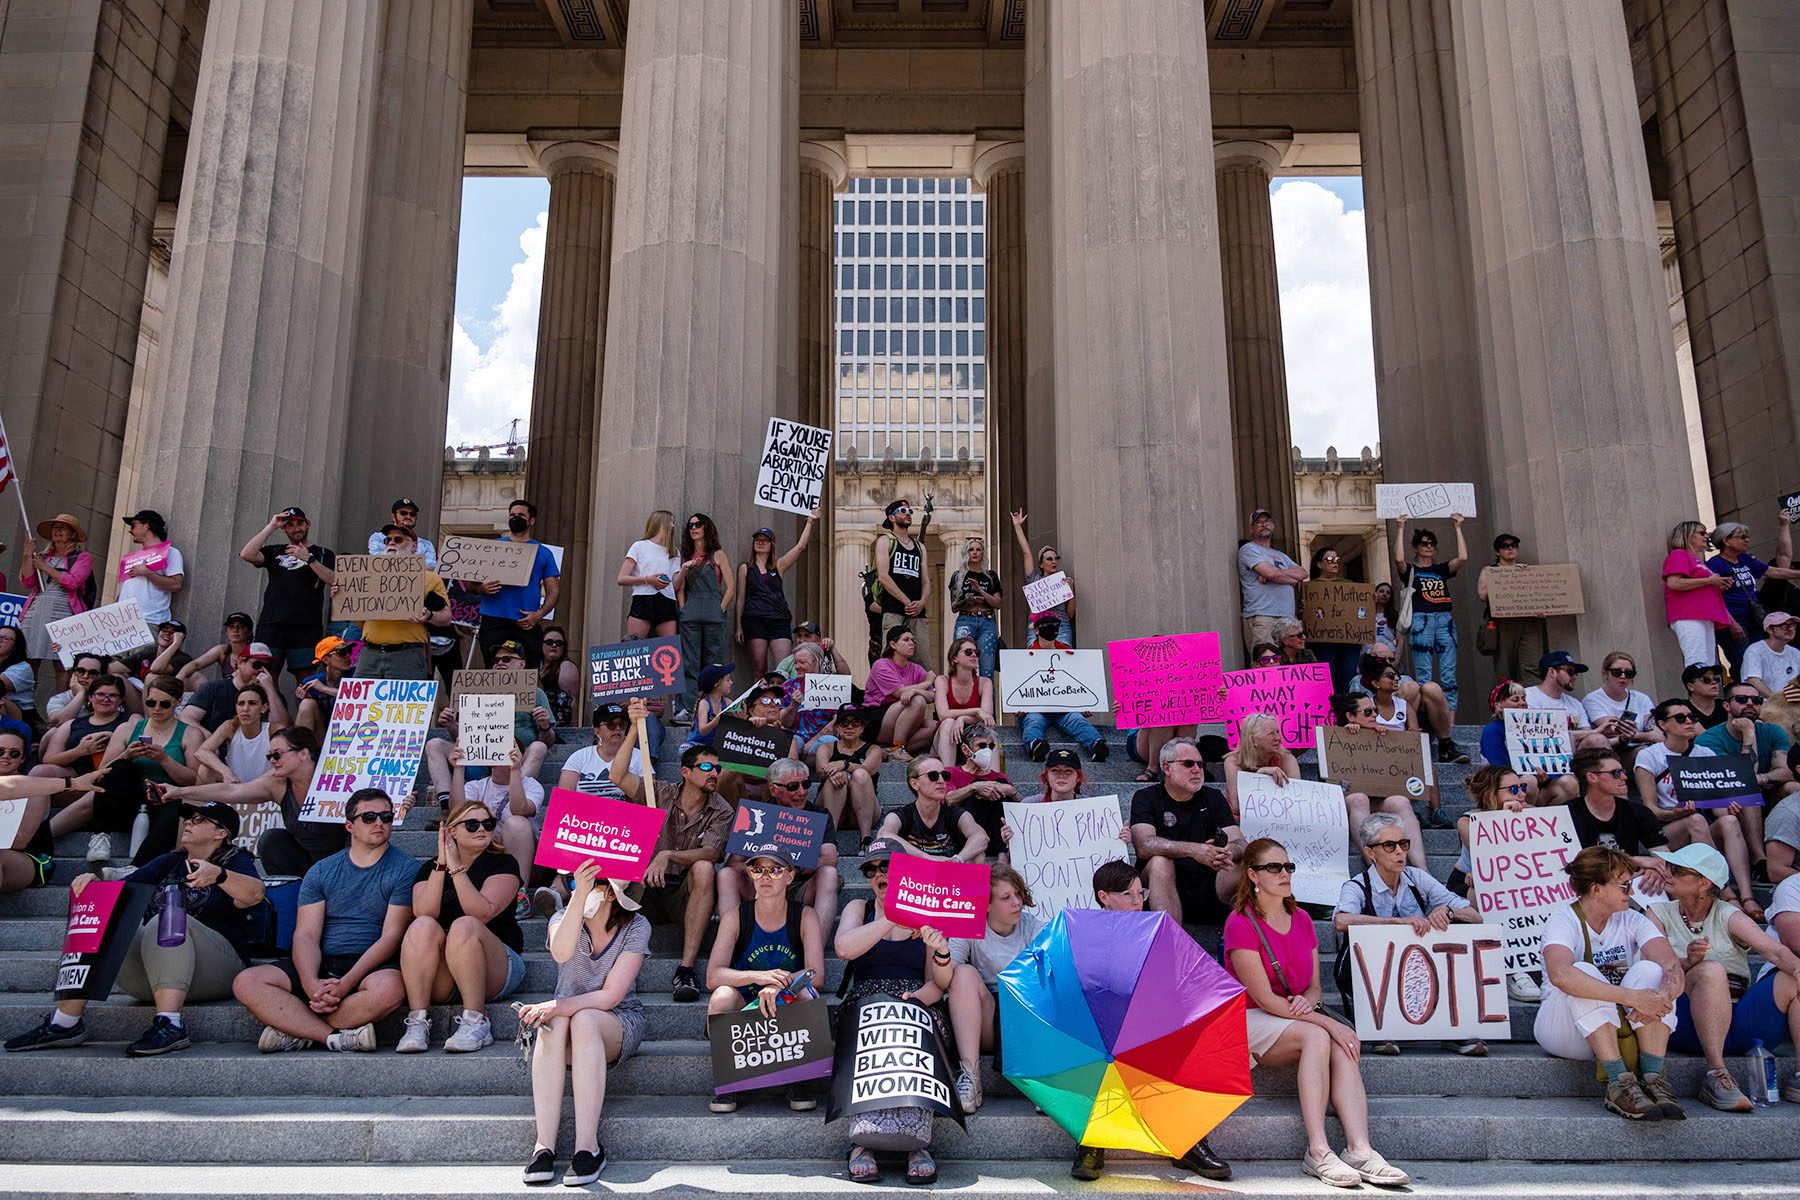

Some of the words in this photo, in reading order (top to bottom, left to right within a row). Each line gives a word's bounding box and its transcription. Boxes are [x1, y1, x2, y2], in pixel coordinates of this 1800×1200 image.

[771, 421, 786, 438] IF
[769, 438, 824, 463] AGAINST
[771, 470, 816, 493] DON'T
[759, 485, 790, 504] GET
[1408, 487, 1446, 515] BANS
[446, 537, 523, 554] Governs
[337, 557, 368, 572] EVEN
[372, 557, 422, 572] CORPSES
[441, 550, 519, 568] Ovaries
[894, 552, 920, 571] BETO
[438, 564, 488, 581] Party
[336, 576, 370, 592] HAVE
[381, 576, 418, 593] BODY
[1421, 581, 1444, 591] 1973
[1323, 587, 1330, 600] A
[1333, 585, 1371, 602] Mother
[341, 596, 419, 613] AUTONOMY
[1331, 604, 1344, 618] for
[50, 624, 87, 639] Being
[89, 603, 143, 631] PRO-LIFE
[1344, 622, 1376, 642] Rights
[69, 634, 104, 650] means
[591, 649, 625, 660] SATURDAY
[626, 647, 640, 655] MAY
[591, 660, 610, 672] WE
[613, 654, 651, 670] WON'T
[454, 672, 518, 687] ABORTION
[525, 672, 536, 685] IS
[592, 672, 610, 685] GO
[611, 668, 646, 682] BACK.
[1040, 674, 1055, 684] We
[1278, 666, 1325, 681] TAKE
[338, 681, 375, 700] NOT
[375, 680, 438, 702] CHURCH
[810, 680, 847, 691] Never
[1019, 688, 1035, 698] Will
[1036, 687, 1051, 697] Not
[1250, 685, 1295, 702] AWAY
[461, 696, 468, 708] If
[477, 696, 481, 708] I
[808, 696, 842, 707] again
[1121, 700, 1153, 714] LIFE
[1264, 701, 1287, 715] MY
[333, 703, 367, 721] NOT
[368, 702, 428, 724] STATE
[464, 723, 472, 733] in
[477, 724, 487, 732] my
[485, 733, 505, 743] fuck
[725, 731, 766, 746] Abortion
[767, 741, 775, 750] is
[1329, 729, 1372, 757] Against
[1517, 737, 1566, 753] YEAR
[723, 741, 753, 755] Health
[755, 749, 777, 760] Care.
[322, 756, 369, 775] MUST
[367, 757, 420, 777] CHOOSE
[1332, 762, 1357, 774] Don't
[1362, 764, 1384, 775] Have
[1680, 770, 1724, 779] Abortion
[1726, 769, 1736, 777] is
[316, 774, 356, 793] HER
[369, 775, 411, 796] FATE
[1253, 776, 1268, 792] I
[1312, 783, 1331, 800] AN
[1682, 780, 1713, 789] Health
[1716, 780, 1746, 788] Care.
[560, 814, 618, 835] Abortion
[621, 826, 631, 838] is
[779, 811, 793, 820] It's
[796, 816, 811, 825] my
[776, 822, 801, 834] Right
[803, 827, 813, 836] to
[1009, 808, 1070, 861] YOUR
[1270, 823, 1290, 832] THAT
[1294, 825, 1312, 833] WAS
[557, 828, 606, 848] Health
[610, 839, 641, 854] Care.
[773, 834, 811, 848] Choose!
[1561, 832, 1573, 843] &
[743, 842, 759, 852] No
[1308, 847, 1340, 872] MORAL
[1476, 848, 1568, 882] UPSET
[899, 876, 949, 895] Abortion
[952, 885, 961, 896] is
[88, 902, 94, 912] is
[898, 889, 940, 908] Health
[942, 897, 976, 910] Care.
[80, 915, 100, 925] Care.
[1508, 916, 1539, 929] SEN.
[748, 945, 774, 963] REDUCE
[1605, 945, 1625, 955] WORDS
[1353, 940, 1507, 1030] VOTE
[861, 1004, 931, 1028] STAND
[730, 1019, 779, 1041] BANS
[860, 1027, 919, 1047] WITH
[731, 1037, 768, 1055] OFF
[768, 1029, 811, 1048] OUR
[734, 1045, 805, 1070] BODIES
[857, 1051, 930, 1073] BLACK
[855, 1076, 947, 1103] WOMEN
